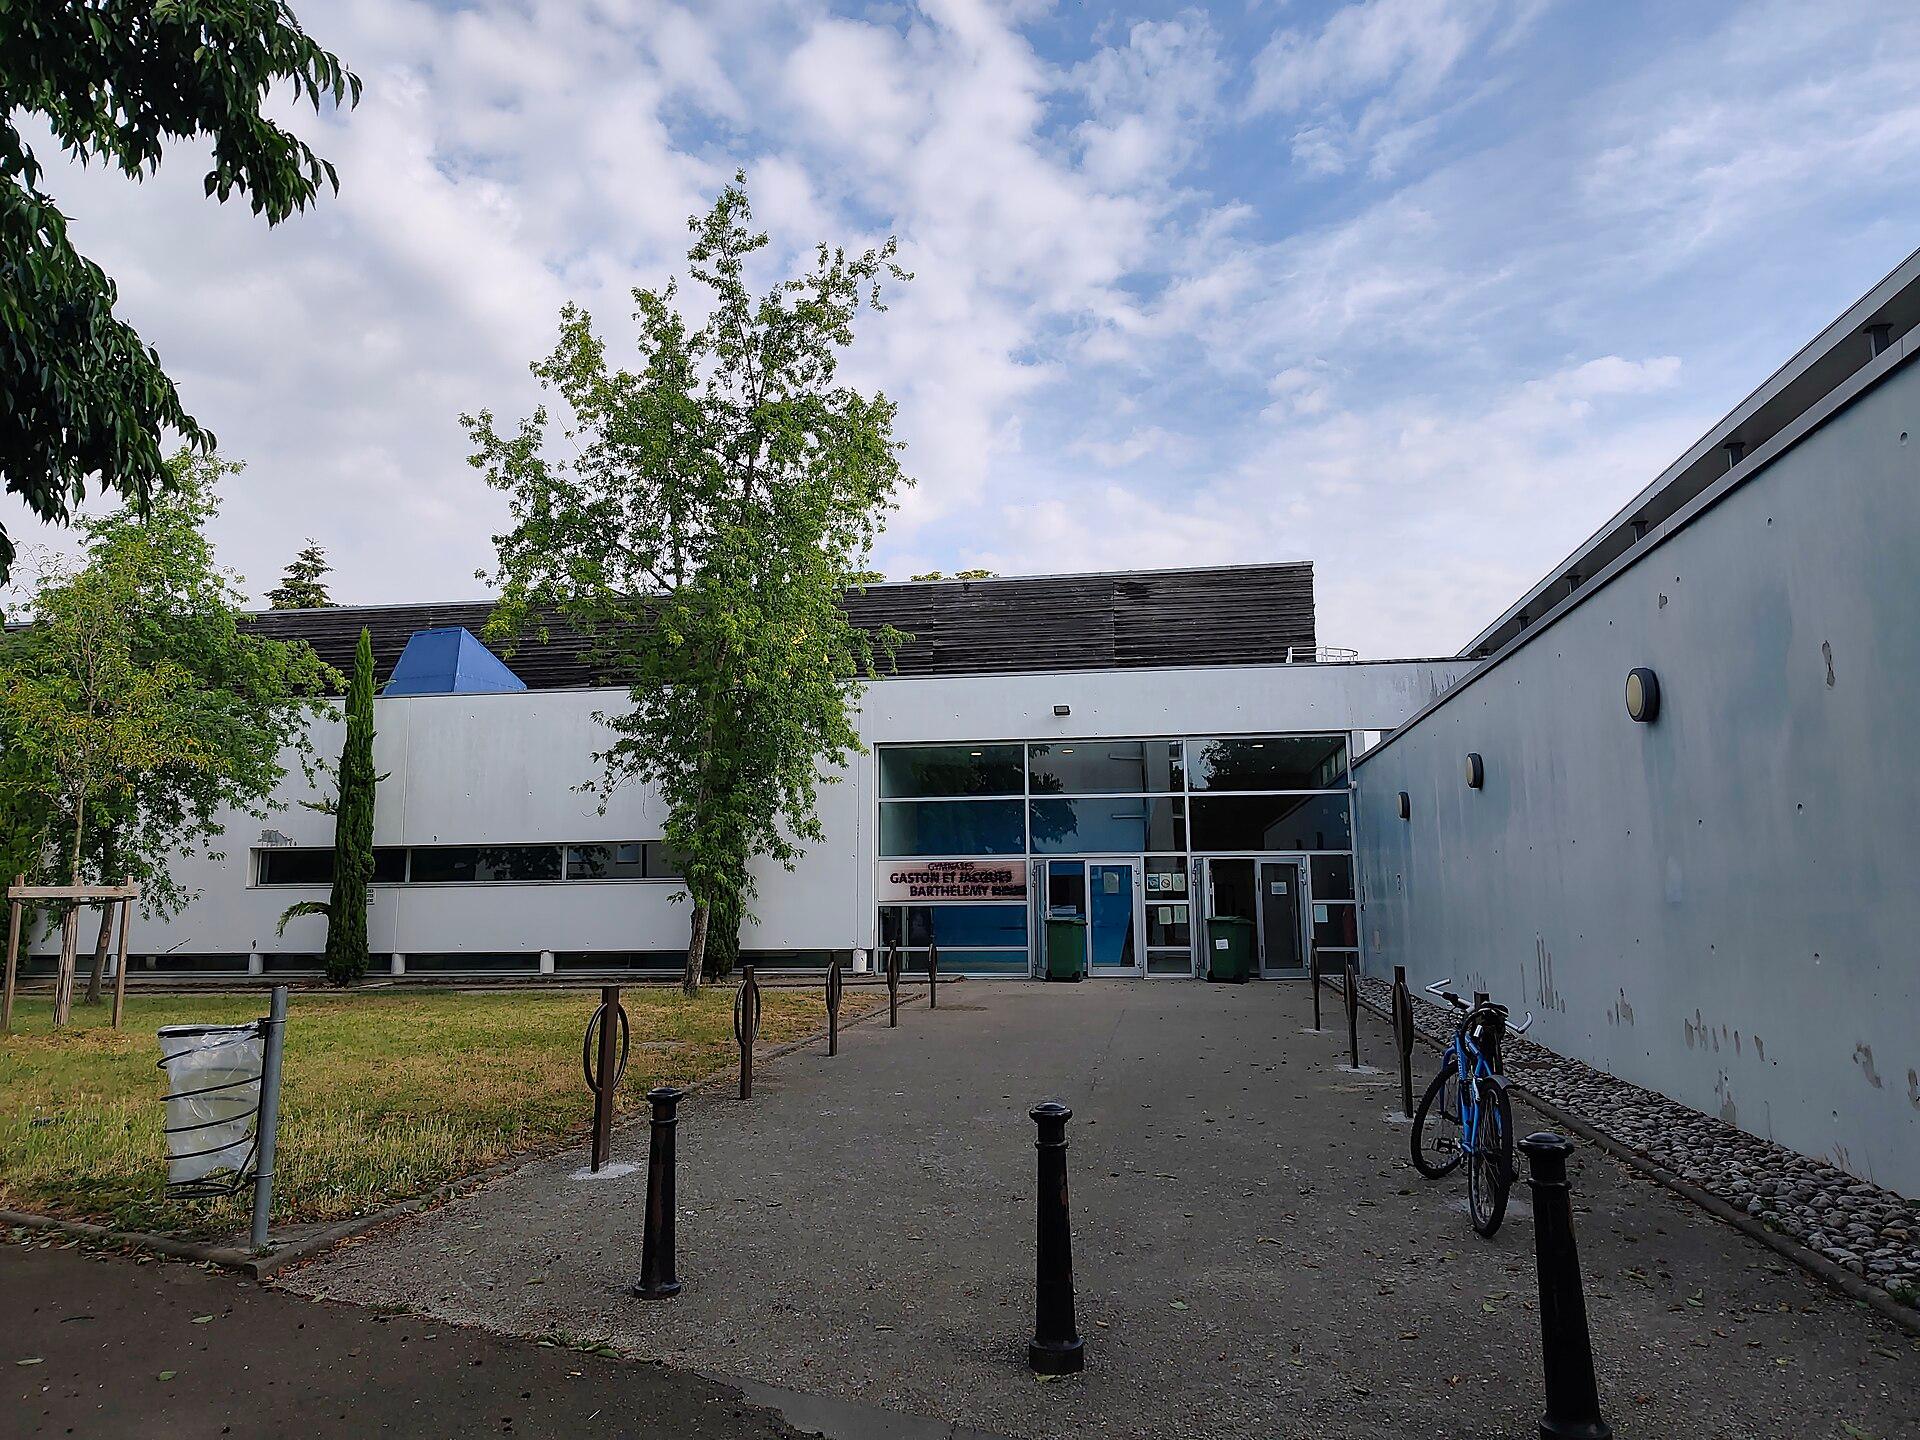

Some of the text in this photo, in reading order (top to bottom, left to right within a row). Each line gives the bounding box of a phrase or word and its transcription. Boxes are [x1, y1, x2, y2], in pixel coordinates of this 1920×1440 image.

[890, 871, 1012, 883] GASTON ET JACQUES
